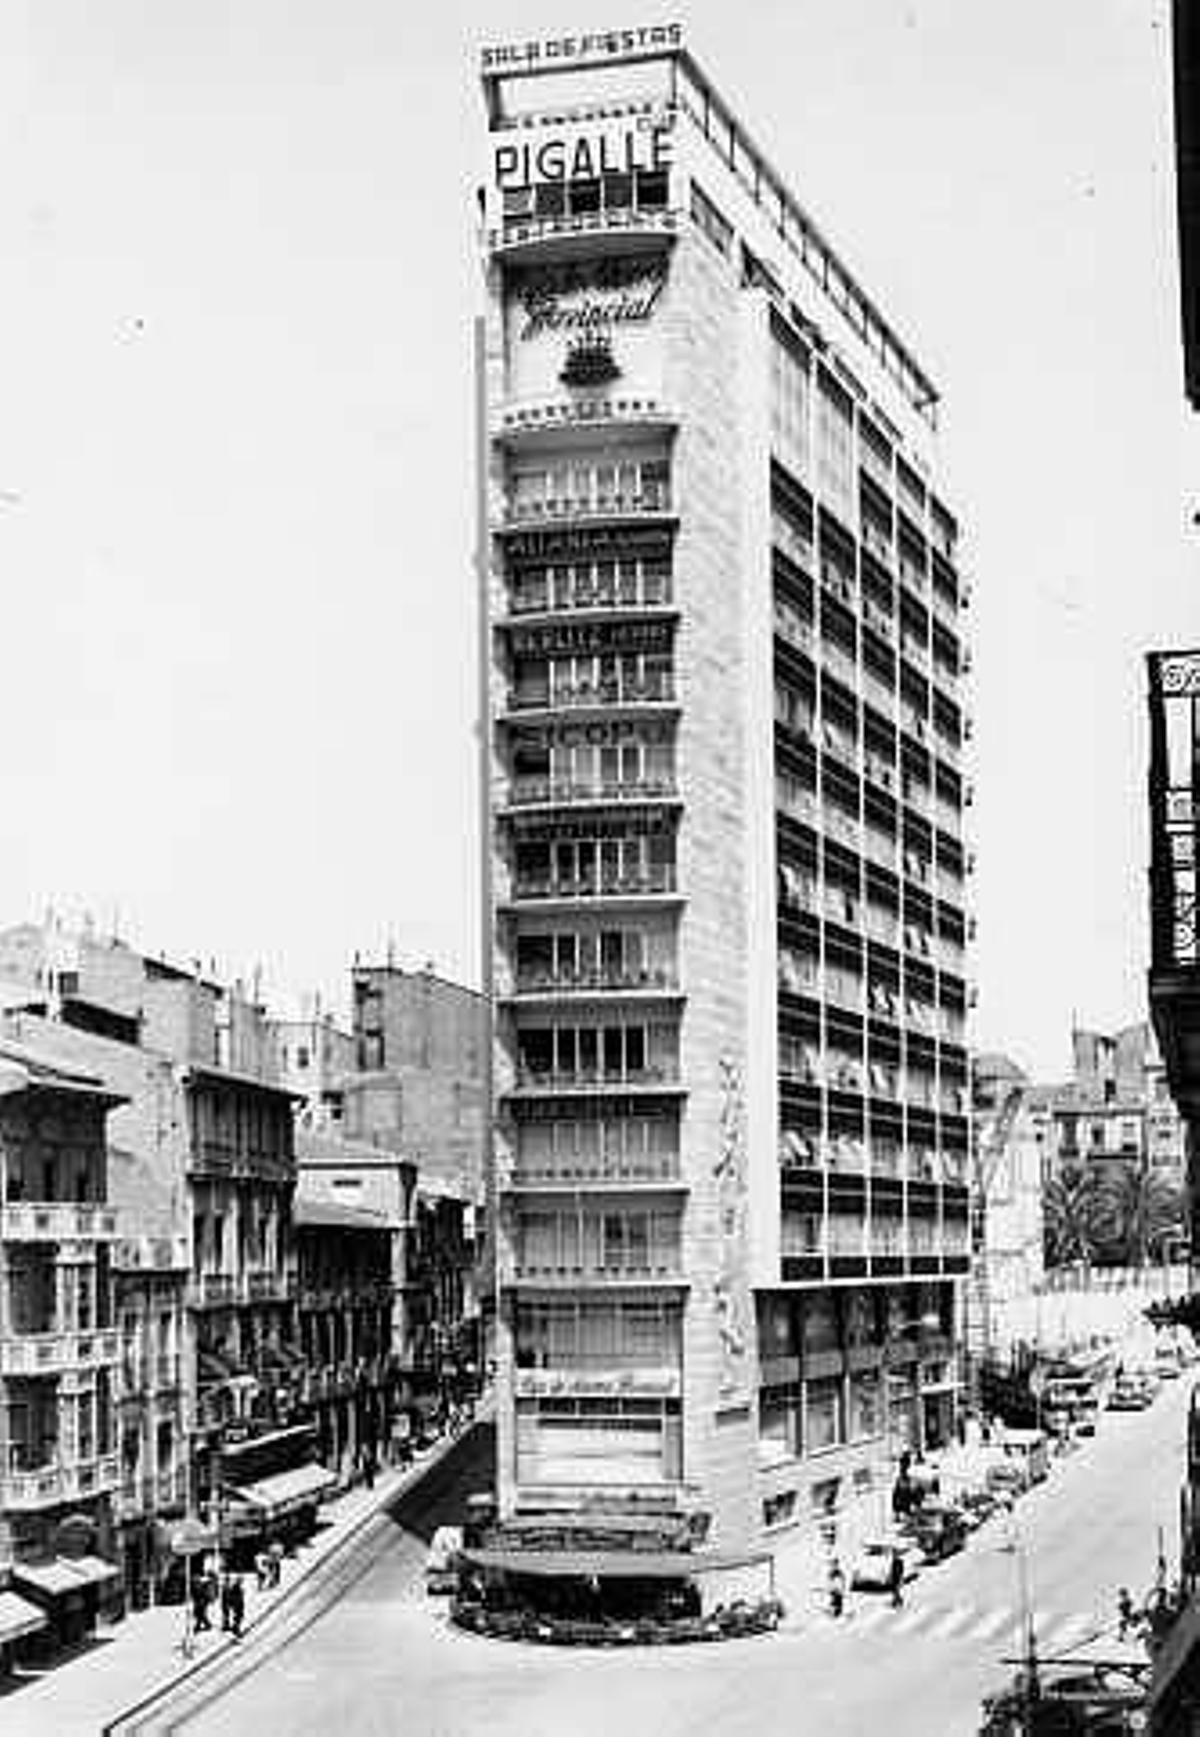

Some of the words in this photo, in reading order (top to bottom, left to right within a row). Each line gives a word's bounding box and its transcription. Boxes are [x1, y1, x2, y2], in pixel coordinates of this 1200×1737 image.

[482, 41, 540, 67] SALA
[546, 37, 577, 58] DE
[581, 22, 681, 54] FIESTAS
[496, 127, 674, 187] PIGALLE
